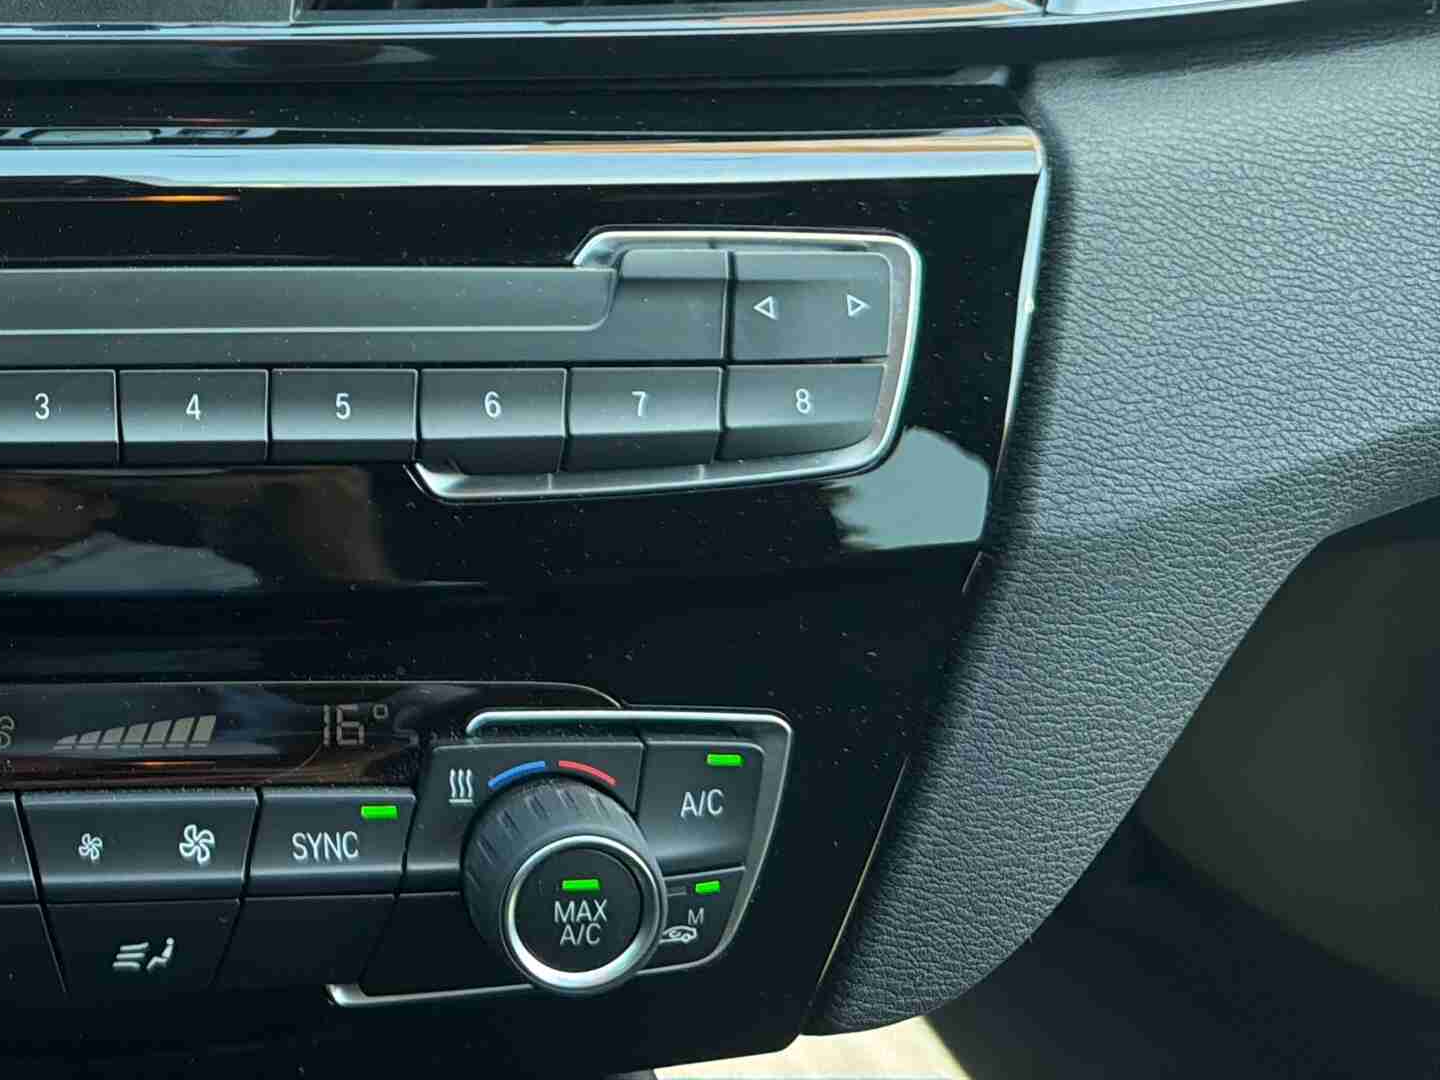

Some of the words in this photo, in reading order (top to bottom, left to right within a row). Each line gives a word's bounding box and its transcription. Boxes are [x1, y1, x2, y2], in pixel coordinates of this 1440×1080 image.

[33, 392, 50, 420] 3
[185, 393, 202, 420] 4
[334, 393, 351, 420] 5
[484, 391, 501, 418] 6
[631, 390, 648, 418] 7
[795, 388, 812, 415] 8
[680, 787, 725, 818] A/C
[291, 831, 360, 862] SYNC
[553, 900, 608, 923] MAX
[687, 907, 705, 925] M
[560, 923, 602, 947] A/C
